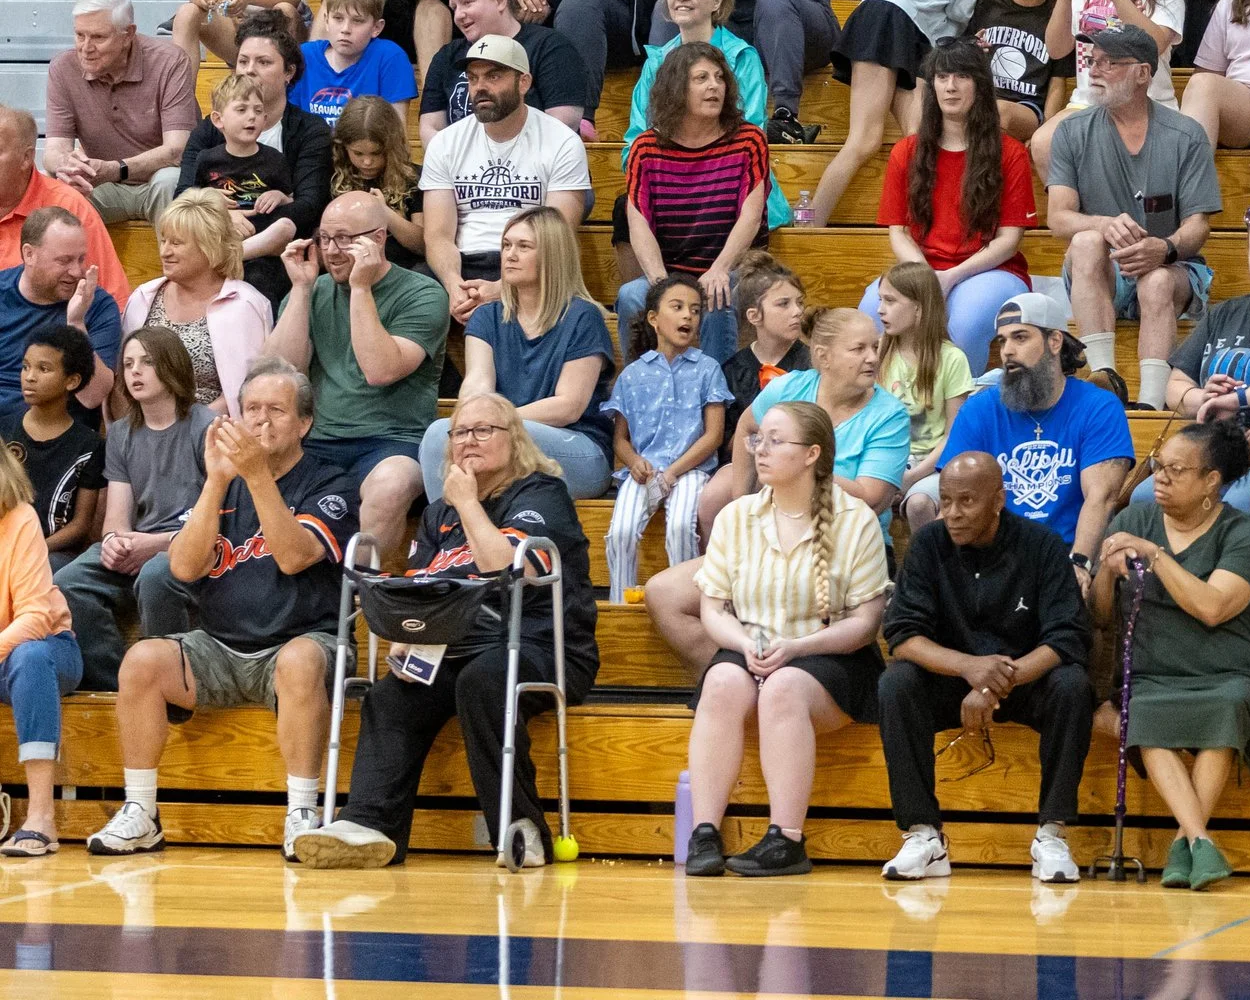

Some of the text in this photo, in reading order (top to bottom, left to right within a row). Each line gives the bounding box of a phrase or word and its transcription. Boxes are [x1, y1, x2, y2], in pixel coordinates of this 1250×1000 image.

[309, 103, 344, 116] BEAUMO
[455, 185, 540, 200] WATERFORD
[997, 448, 1076, 476] Softball
